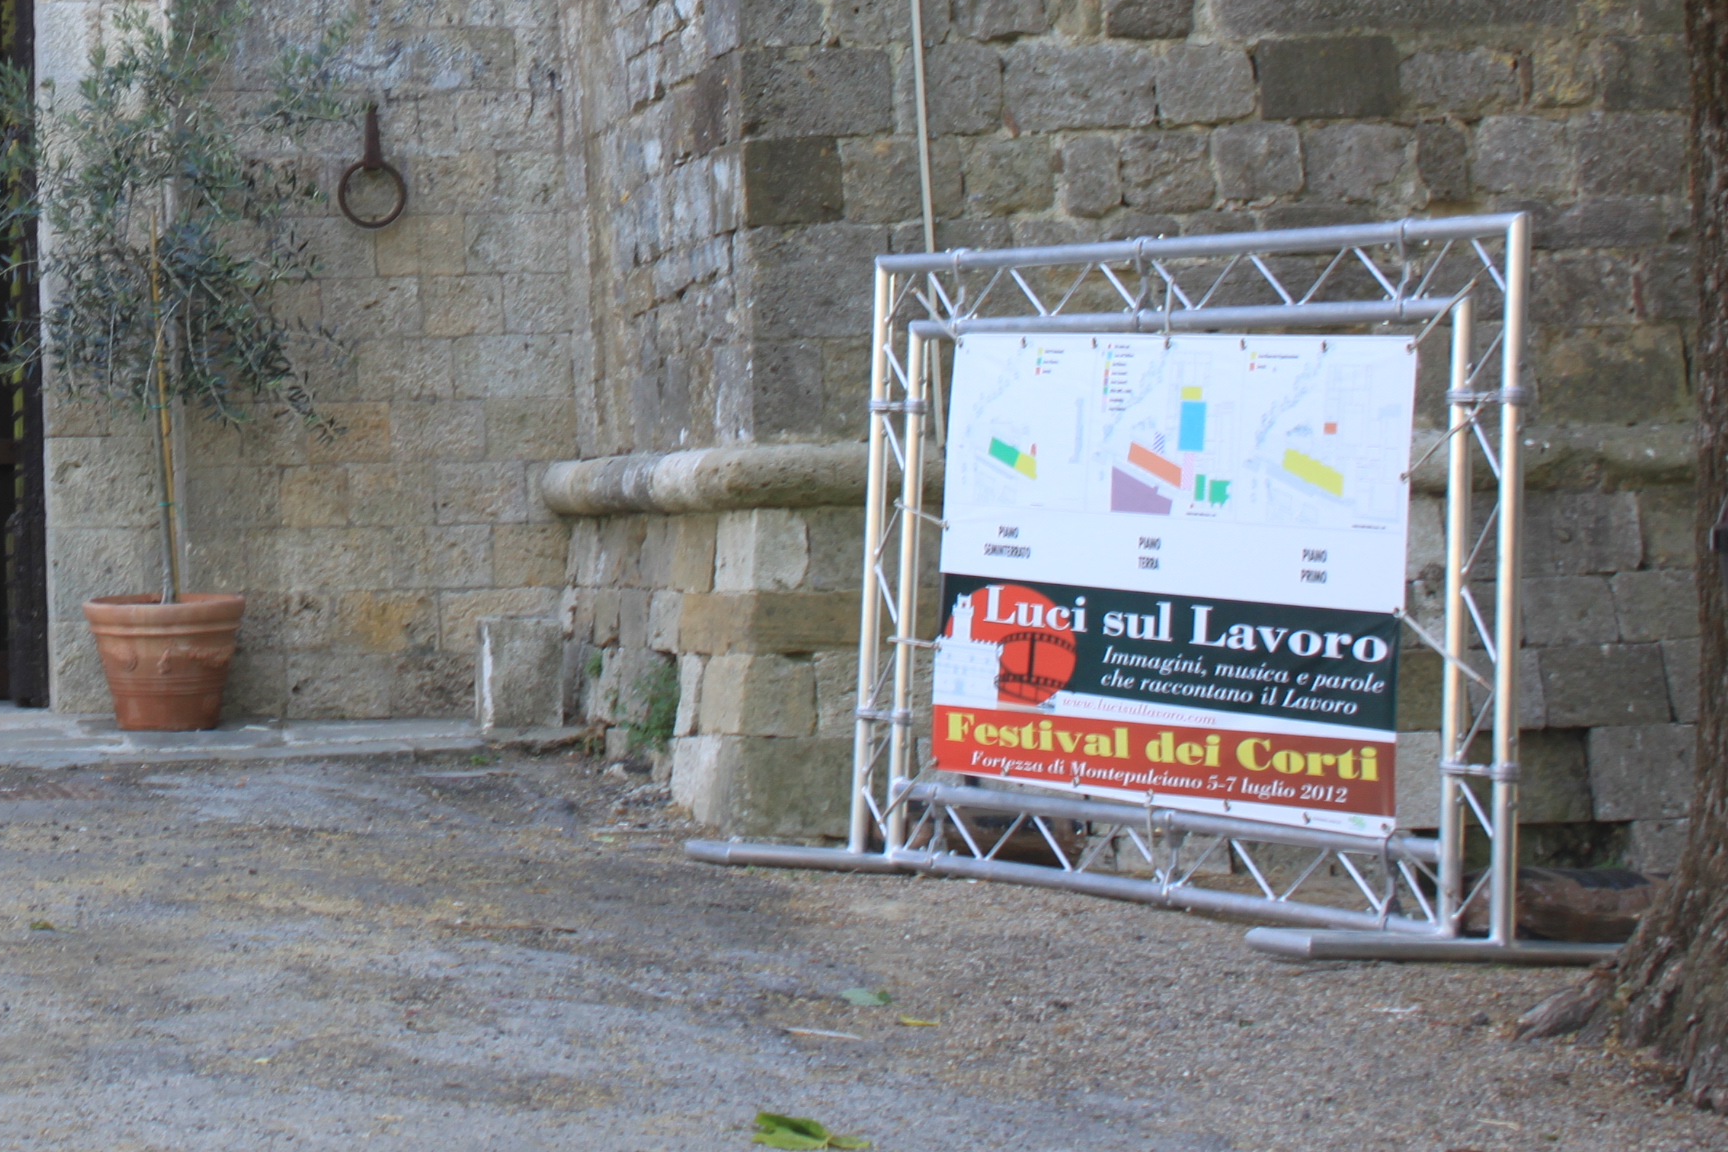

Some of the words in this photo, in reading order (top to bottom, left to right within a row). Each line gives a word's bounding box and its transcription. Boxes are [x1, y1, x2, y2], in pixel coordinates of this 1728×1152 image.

[999, 526, 1019, 539] PIANO
[1139, 537, 1161, 550] PIANO
[983, 543, 1031, 559] SEMINTERRATO
[1303, 548, 1327, 563] PIANO
[1139, 556, 1159, 570] TERRA
[1301, 569, 1327, 583] PRIMO
[983, 584, 1088, 633] Luci
[1102, 600, 1173, 642] sul
[1188, 604, 1389, 663] Lavoro
[1101, 646, 1207, 677] Immagini,
[1214, 662, 1290, 684] musica
[1296, 671, 1309, 686] e
[1310, 672, 1386, 693] parole
[1100, 669, 1135, 688] che
[1140, 677, 1253, 703] raccontano
[1260, 686, 1278, 706] il
[1282, 689, 1358, 715] Lavoro
[1063, 696, 1216, 725] www.lucisullavoro.com
[945, 711, 1130, 759] Festival
[1145, 730, 1221, 768] dei
[1235, 737, 1380, 782] Corti
[970, 750, 1044, 773] Fortezza
[1047, 758, 1065, 775] di
[1072, 761, 1202, 787] Montepulciano
[1206, 774, 1237, 794] 5-7
[1240, 777, 1296, 799] luglio
[1299, 783, 1349, 803] 2012
